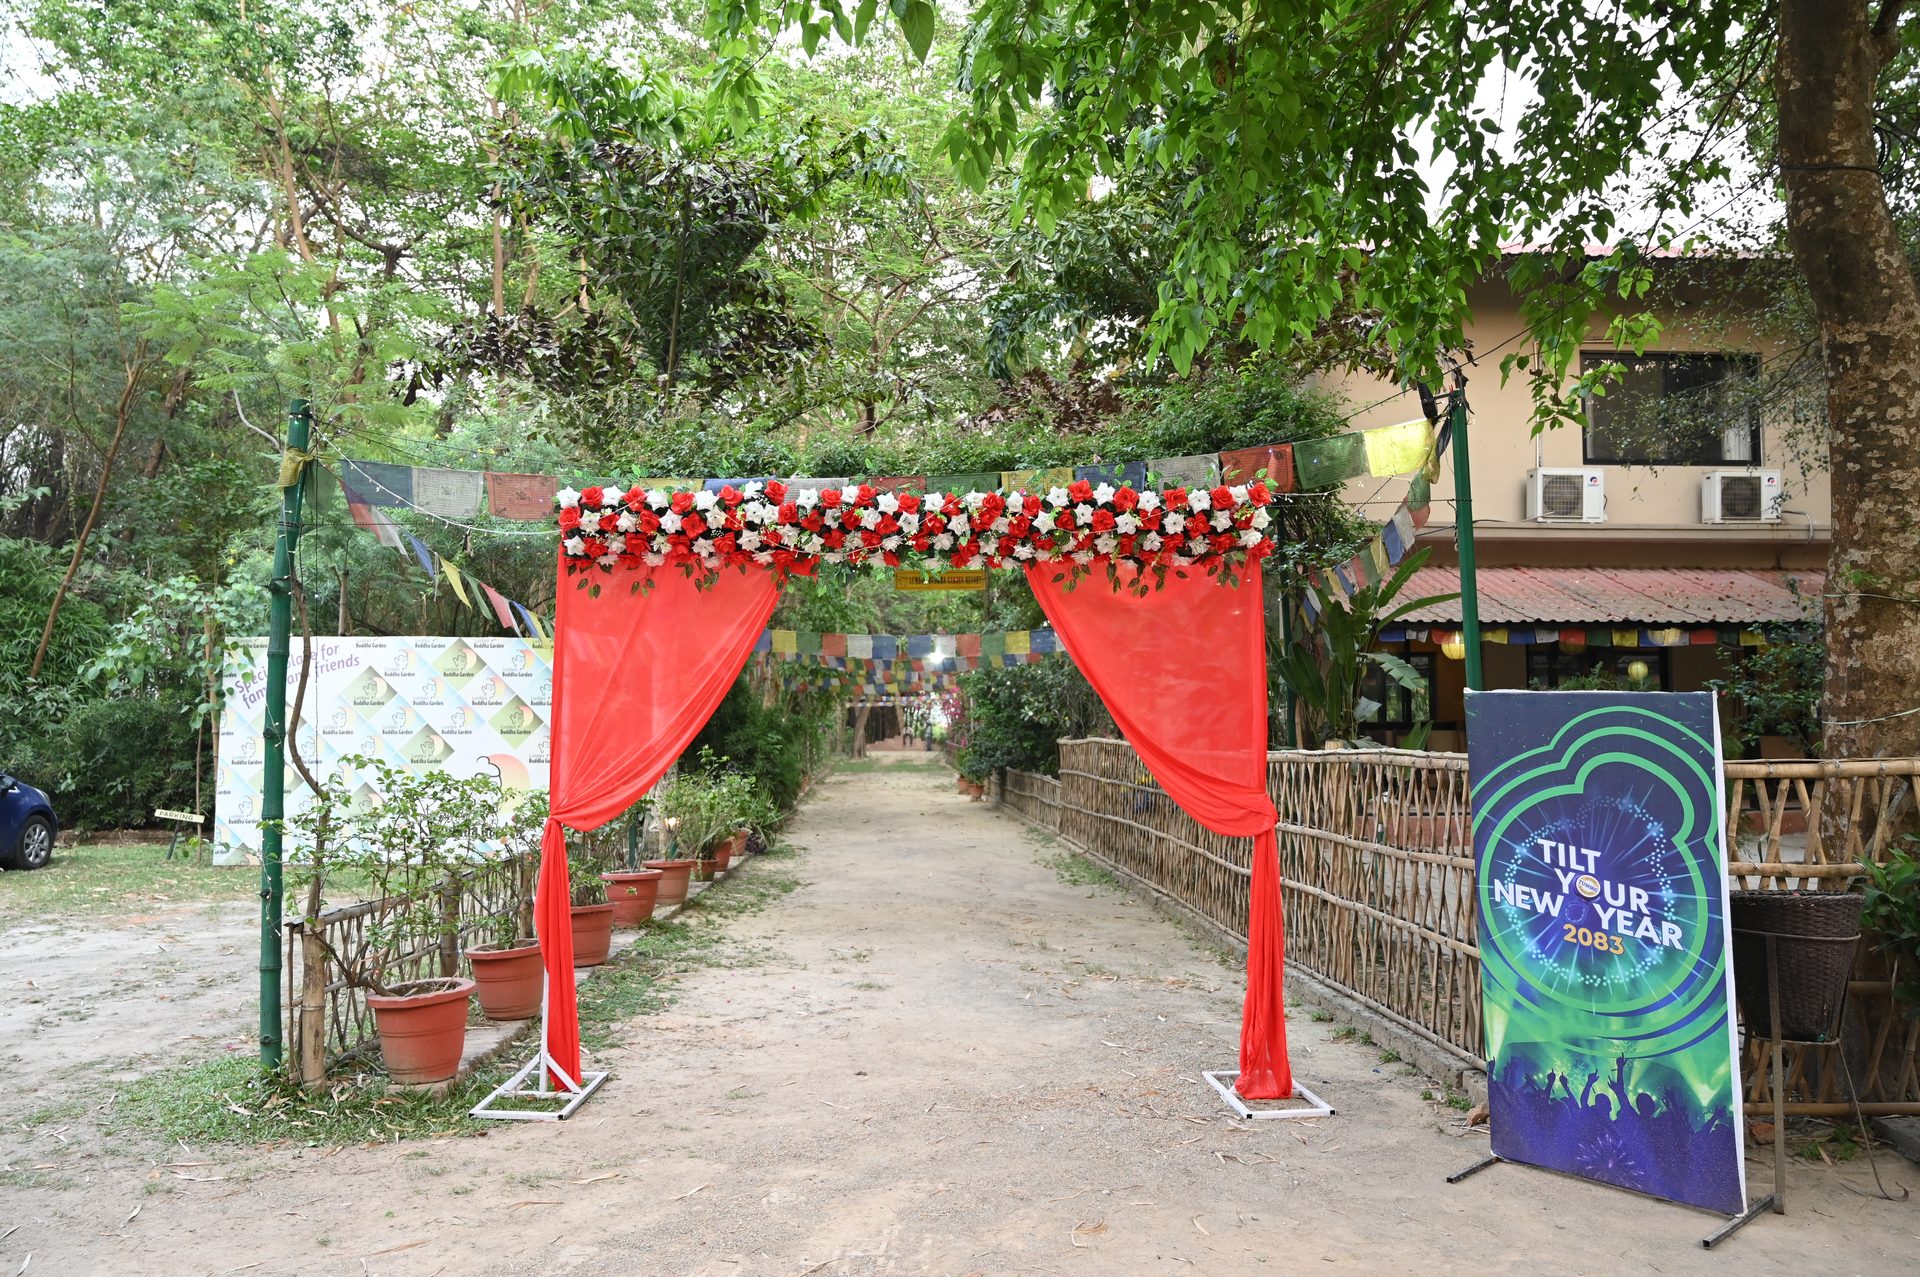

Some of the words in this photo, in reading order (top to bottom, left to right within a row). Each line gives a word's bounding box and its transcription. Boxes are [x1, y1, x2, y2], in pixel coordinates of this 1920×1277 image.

[321, 643, 340, 660] for
[316, 654, 360, 678] friends
[160, 811, 193, 820] PARKING
[1538, 838, 1601, 874] TILT
[1494, 878, 1564, 918] NEW
[1593, 902, 1684, 950] YEAR
[1563, 924, 1624, 955] 2083
